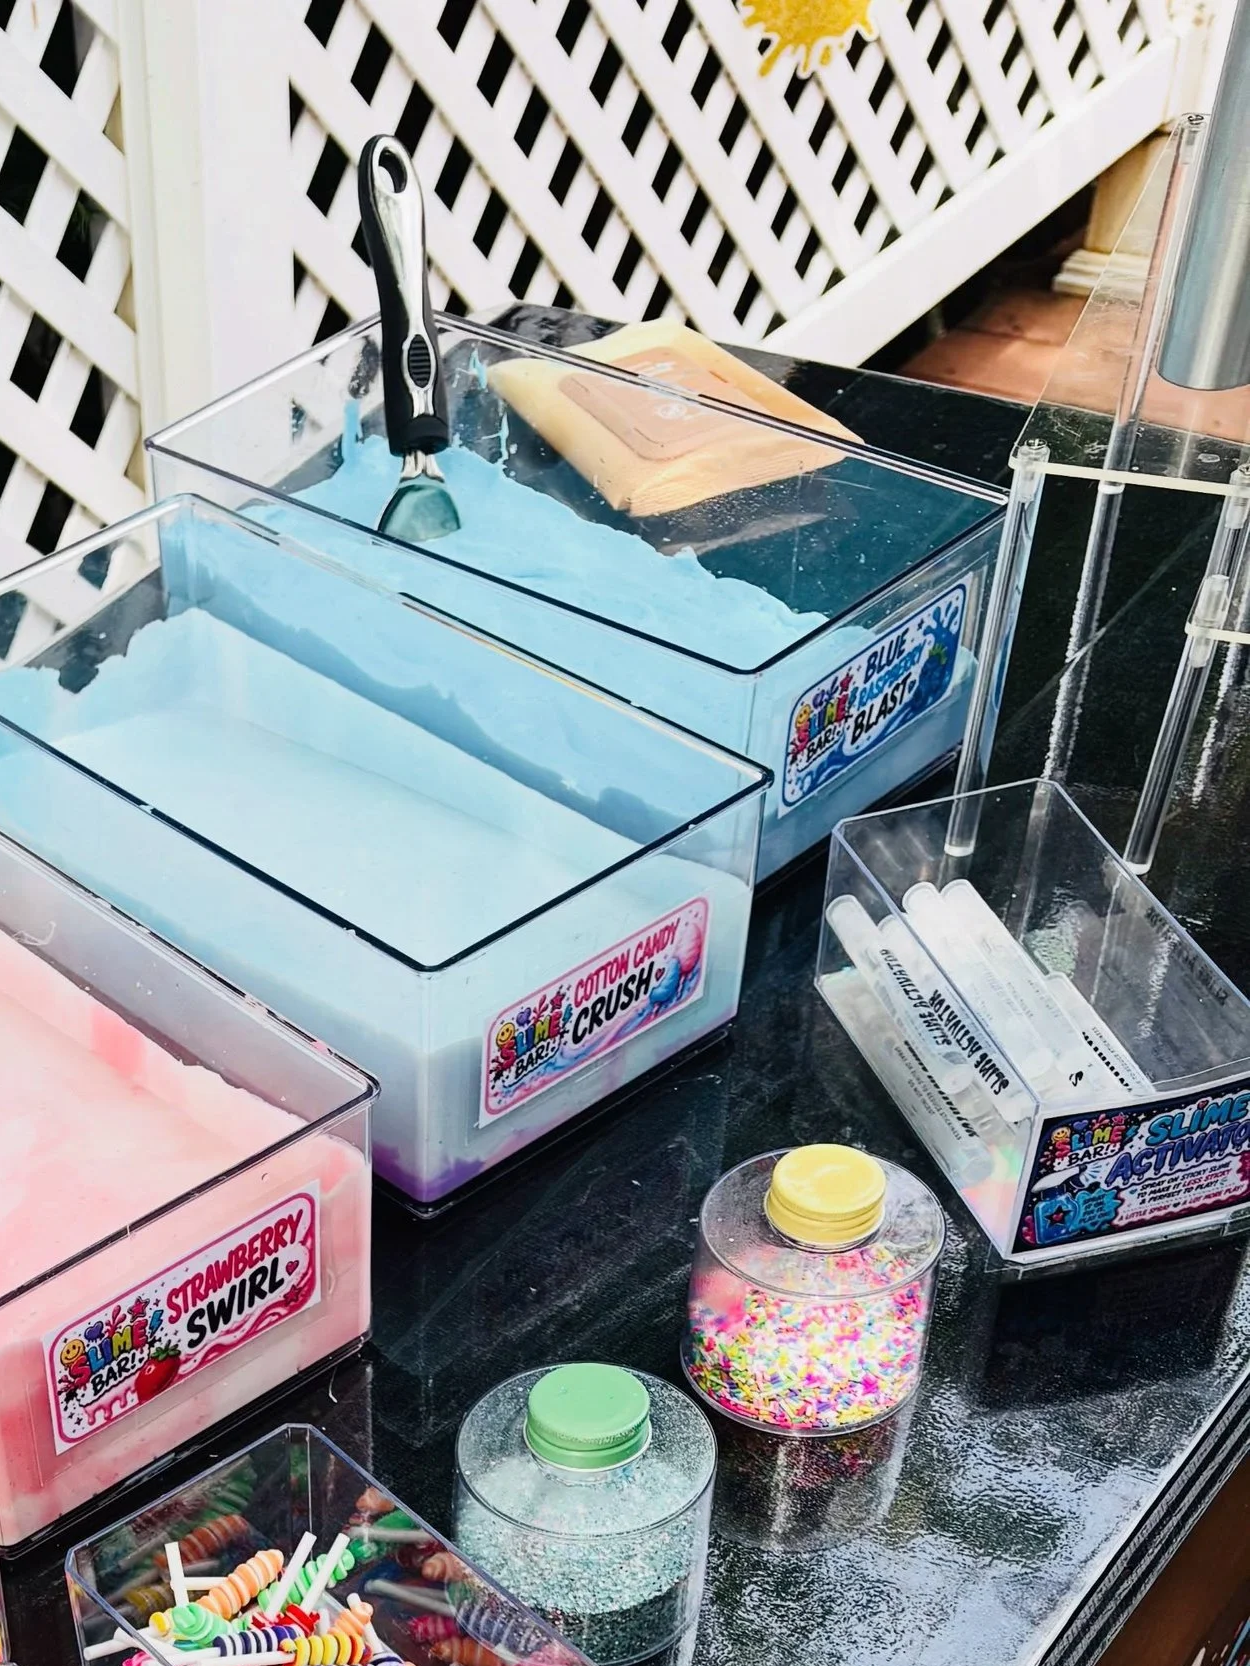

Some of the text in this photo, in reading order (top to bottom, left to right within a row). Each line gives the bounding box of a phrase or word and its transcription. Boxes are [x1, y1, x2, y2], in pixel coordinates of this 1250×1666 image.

[857, 639, 926, 710] RASPBERRY
[864, 628, 909, 684] BLUE
[851, 672, 912, 745] BLAST
[806, 726, 837, 762] BAR!
[574, 918, 681, 1008] COTTON CANDY
[881, 948, 928, 1009] ACTIVATOR
[572, 962, 654, 1046] CRUSH
[919, 1010, 952, 1046] SLIME
[929, 989, 983, 1059] ACTIVATOR
[499, 1011, 562, 1070] SLIME
[515, 1041, 552, 1079] BAR!
[974, 1052, 1010, 1095] SLIME
[1055, 1125, 1126, 1160] SLIME
[1146, 1092, 1250, 1146] SLIME
[1068, 1145, 1111, 1166] BAR!
[1105, 1121, 1250, 1187] ACTIVATO
[166, 1208, 304, 1325] STRAWBERRY
[186, 1257, 285, 1349] SWIRL
[68, 1320, 149, 1389] SLIME
[90, 1353, 137, 1396] BAR!
